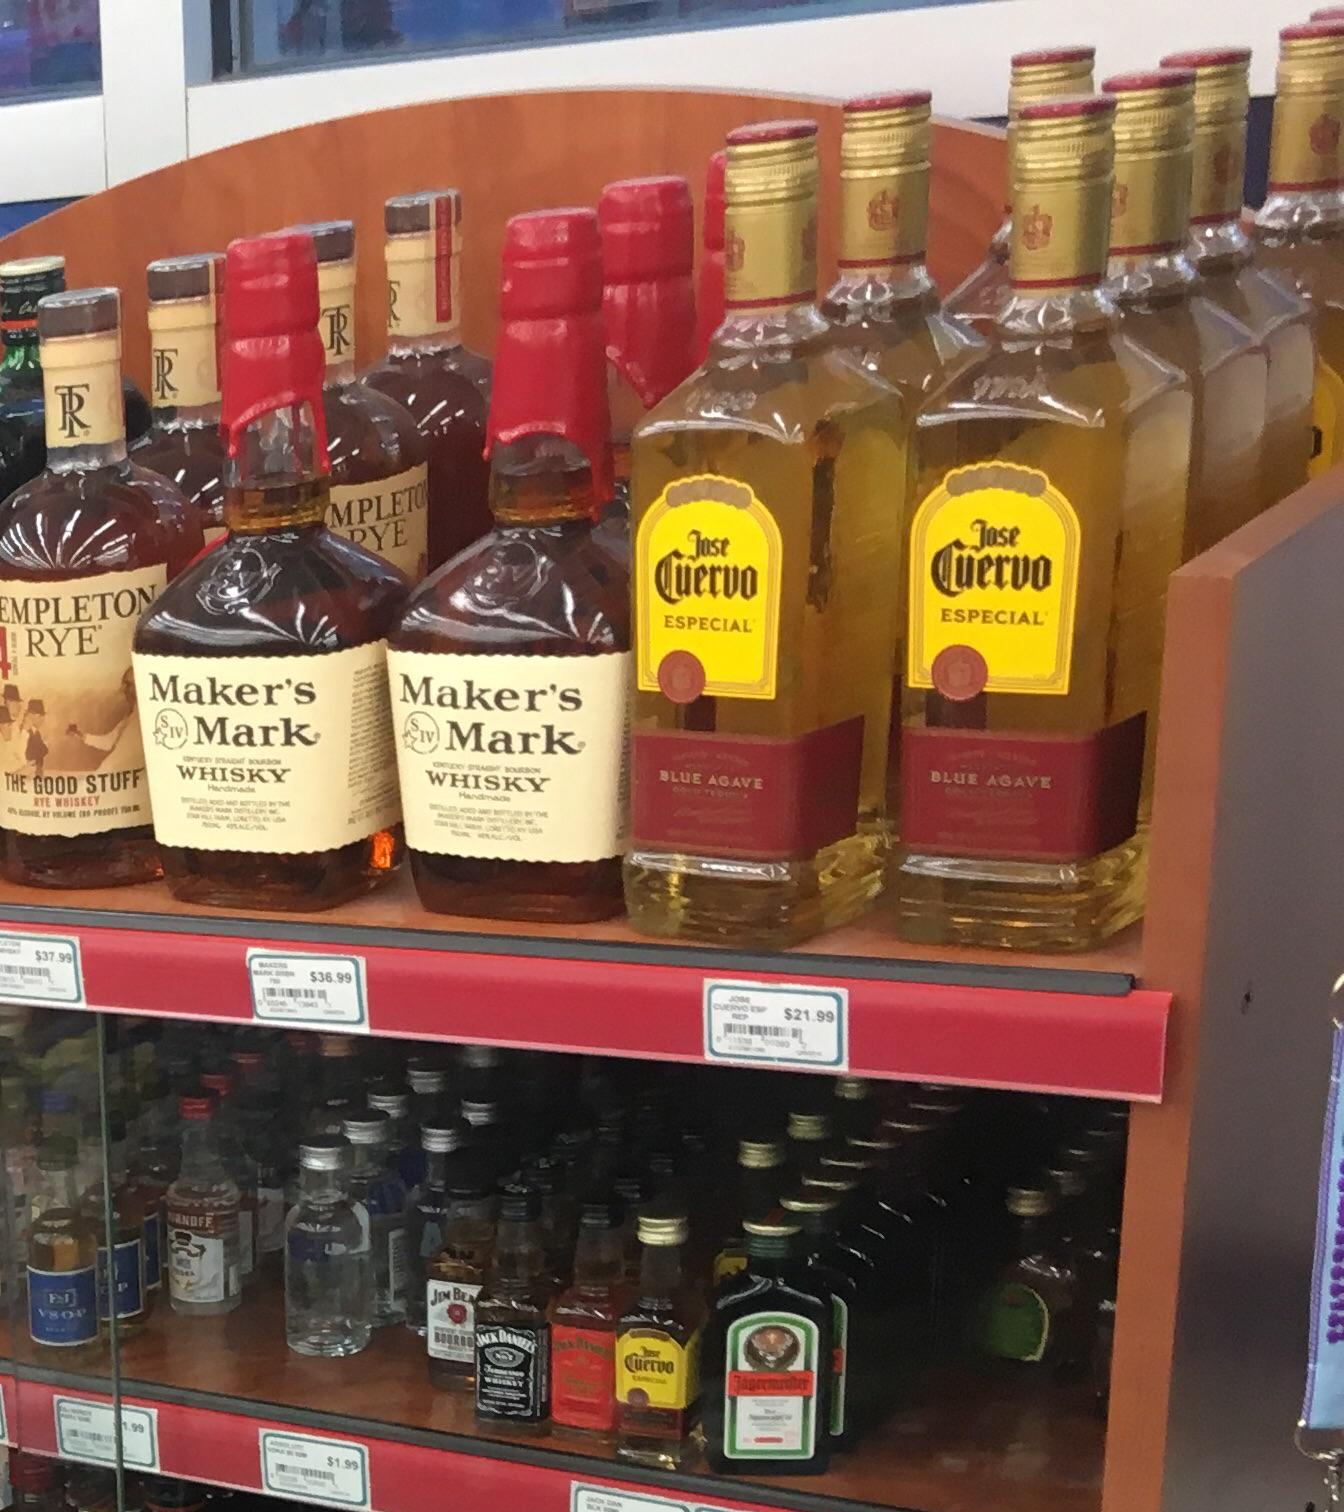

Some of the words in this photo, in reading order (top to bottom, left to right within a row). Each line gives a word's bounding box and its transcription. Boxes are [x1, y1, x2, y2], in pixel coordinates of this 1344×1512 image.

[971, 519, 1020, 550] Jose
[688, 530, 729, 562] Jose
[655, 549, 758, 603] Cuervo
[932, 538, 1051, 597] Cuervo
[664, 616, 752, 633] ESPECIAL
[941, 609, 1044, 626] ESPECIAL
[26, 626, 100, 658] RYE
[149, 673, 317, 706] Maker's
[400, 673, 582, 712] Maker's
[161, 715, 168, 728] S
[171, 727, 184, 738] IV
[193, 716, 316, 748] Mark
[411, 718, 419, 731] S
[420, 730, 434, 743] IV
[445, 720, 583, 755] Mark
[4, 772, 27, 793] THE
[33, 775, 77, 795] GOOD
[86, 768, 146, 793] STUFF
[176, 765, 291, 783] WHISKY
[426, 770, 550, 792] WHISKY
[660, 770, 701, 786] BLUE
[708, 774, 764, 790] AGAVE
[930, 769, 979, 787] BLUE
[987, 775, 1052, 790] AGAVE
[34, 798, 50, 807] RYE
[56, 796, 100, 807] WHISKEY
[34, 950, 73, 964] $37.99
[309, 970, 353, 985] $36.99
[784, 1007, 835, 1023] $21.99
[624, 1353, 674, 1375] Cuervo
[326, 1455, 359, 1471] $1.99
